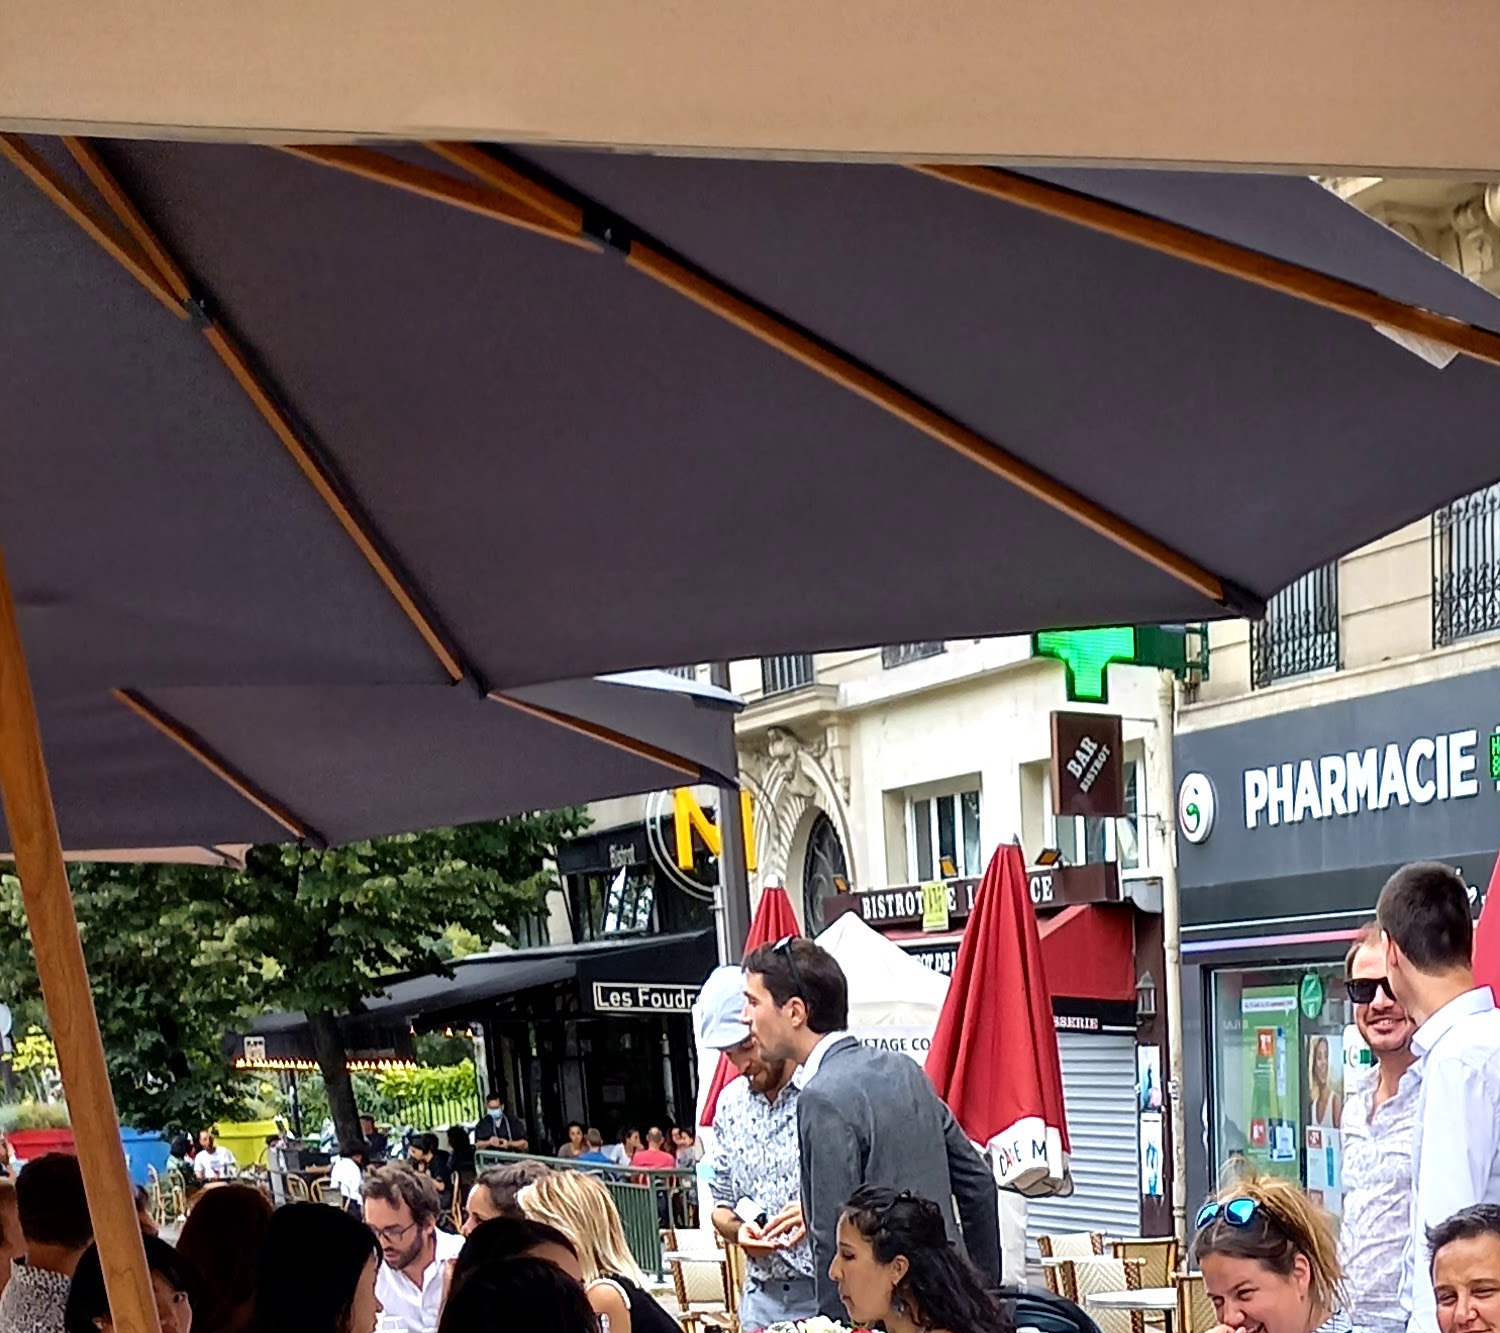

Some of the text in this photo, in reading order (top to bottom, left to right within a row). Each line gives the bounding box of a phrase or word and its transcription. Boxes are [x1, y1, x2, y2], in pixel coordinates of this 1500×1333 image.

[1066, 736, 1098, 779] BAR
[1080, 744, 1111, 793] BISTROT
[1244, 730, 1479, 829] PHARMACIE
[861, 890, 924, 920] BISTROT
[1030, 876, 1053, 903] CE
[597, 984, 696, 1009] Les Foudr
[1053, 1015, 1099, 1030] SSERIE
[911, 1037, 932, 1051] CO
[1031, 1138, 1047, 1161] M
